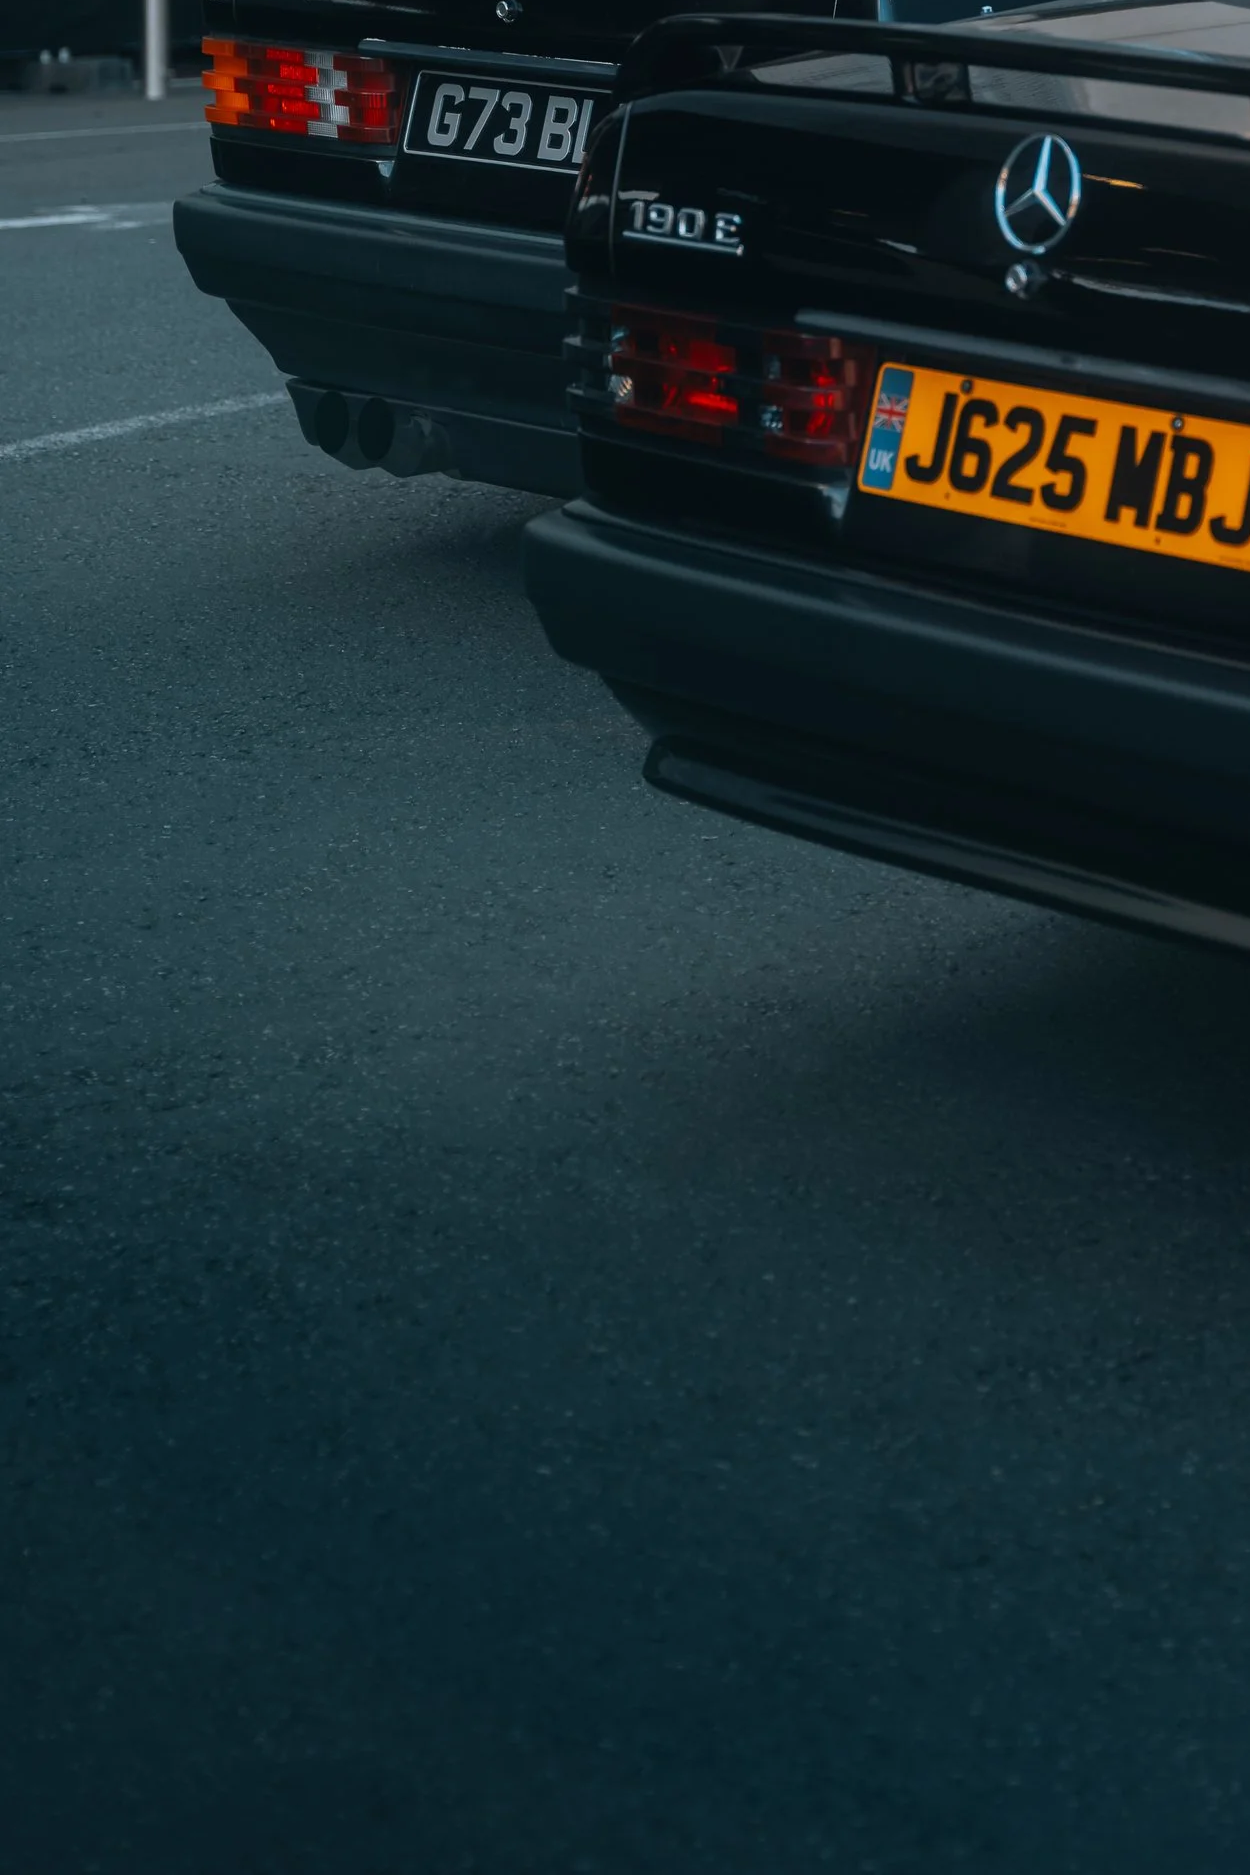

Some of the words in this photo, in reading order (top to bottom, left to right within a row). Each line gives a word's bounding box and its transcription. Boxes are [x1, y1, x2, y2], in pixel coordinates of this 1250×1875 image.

[427, 82, 533, 157] G73
[629, 200, 707, 239] 190
[715, 211, 743, 244] E
[868, 447, 894, 474] UK
[904, 391, 1099, 513] J625
